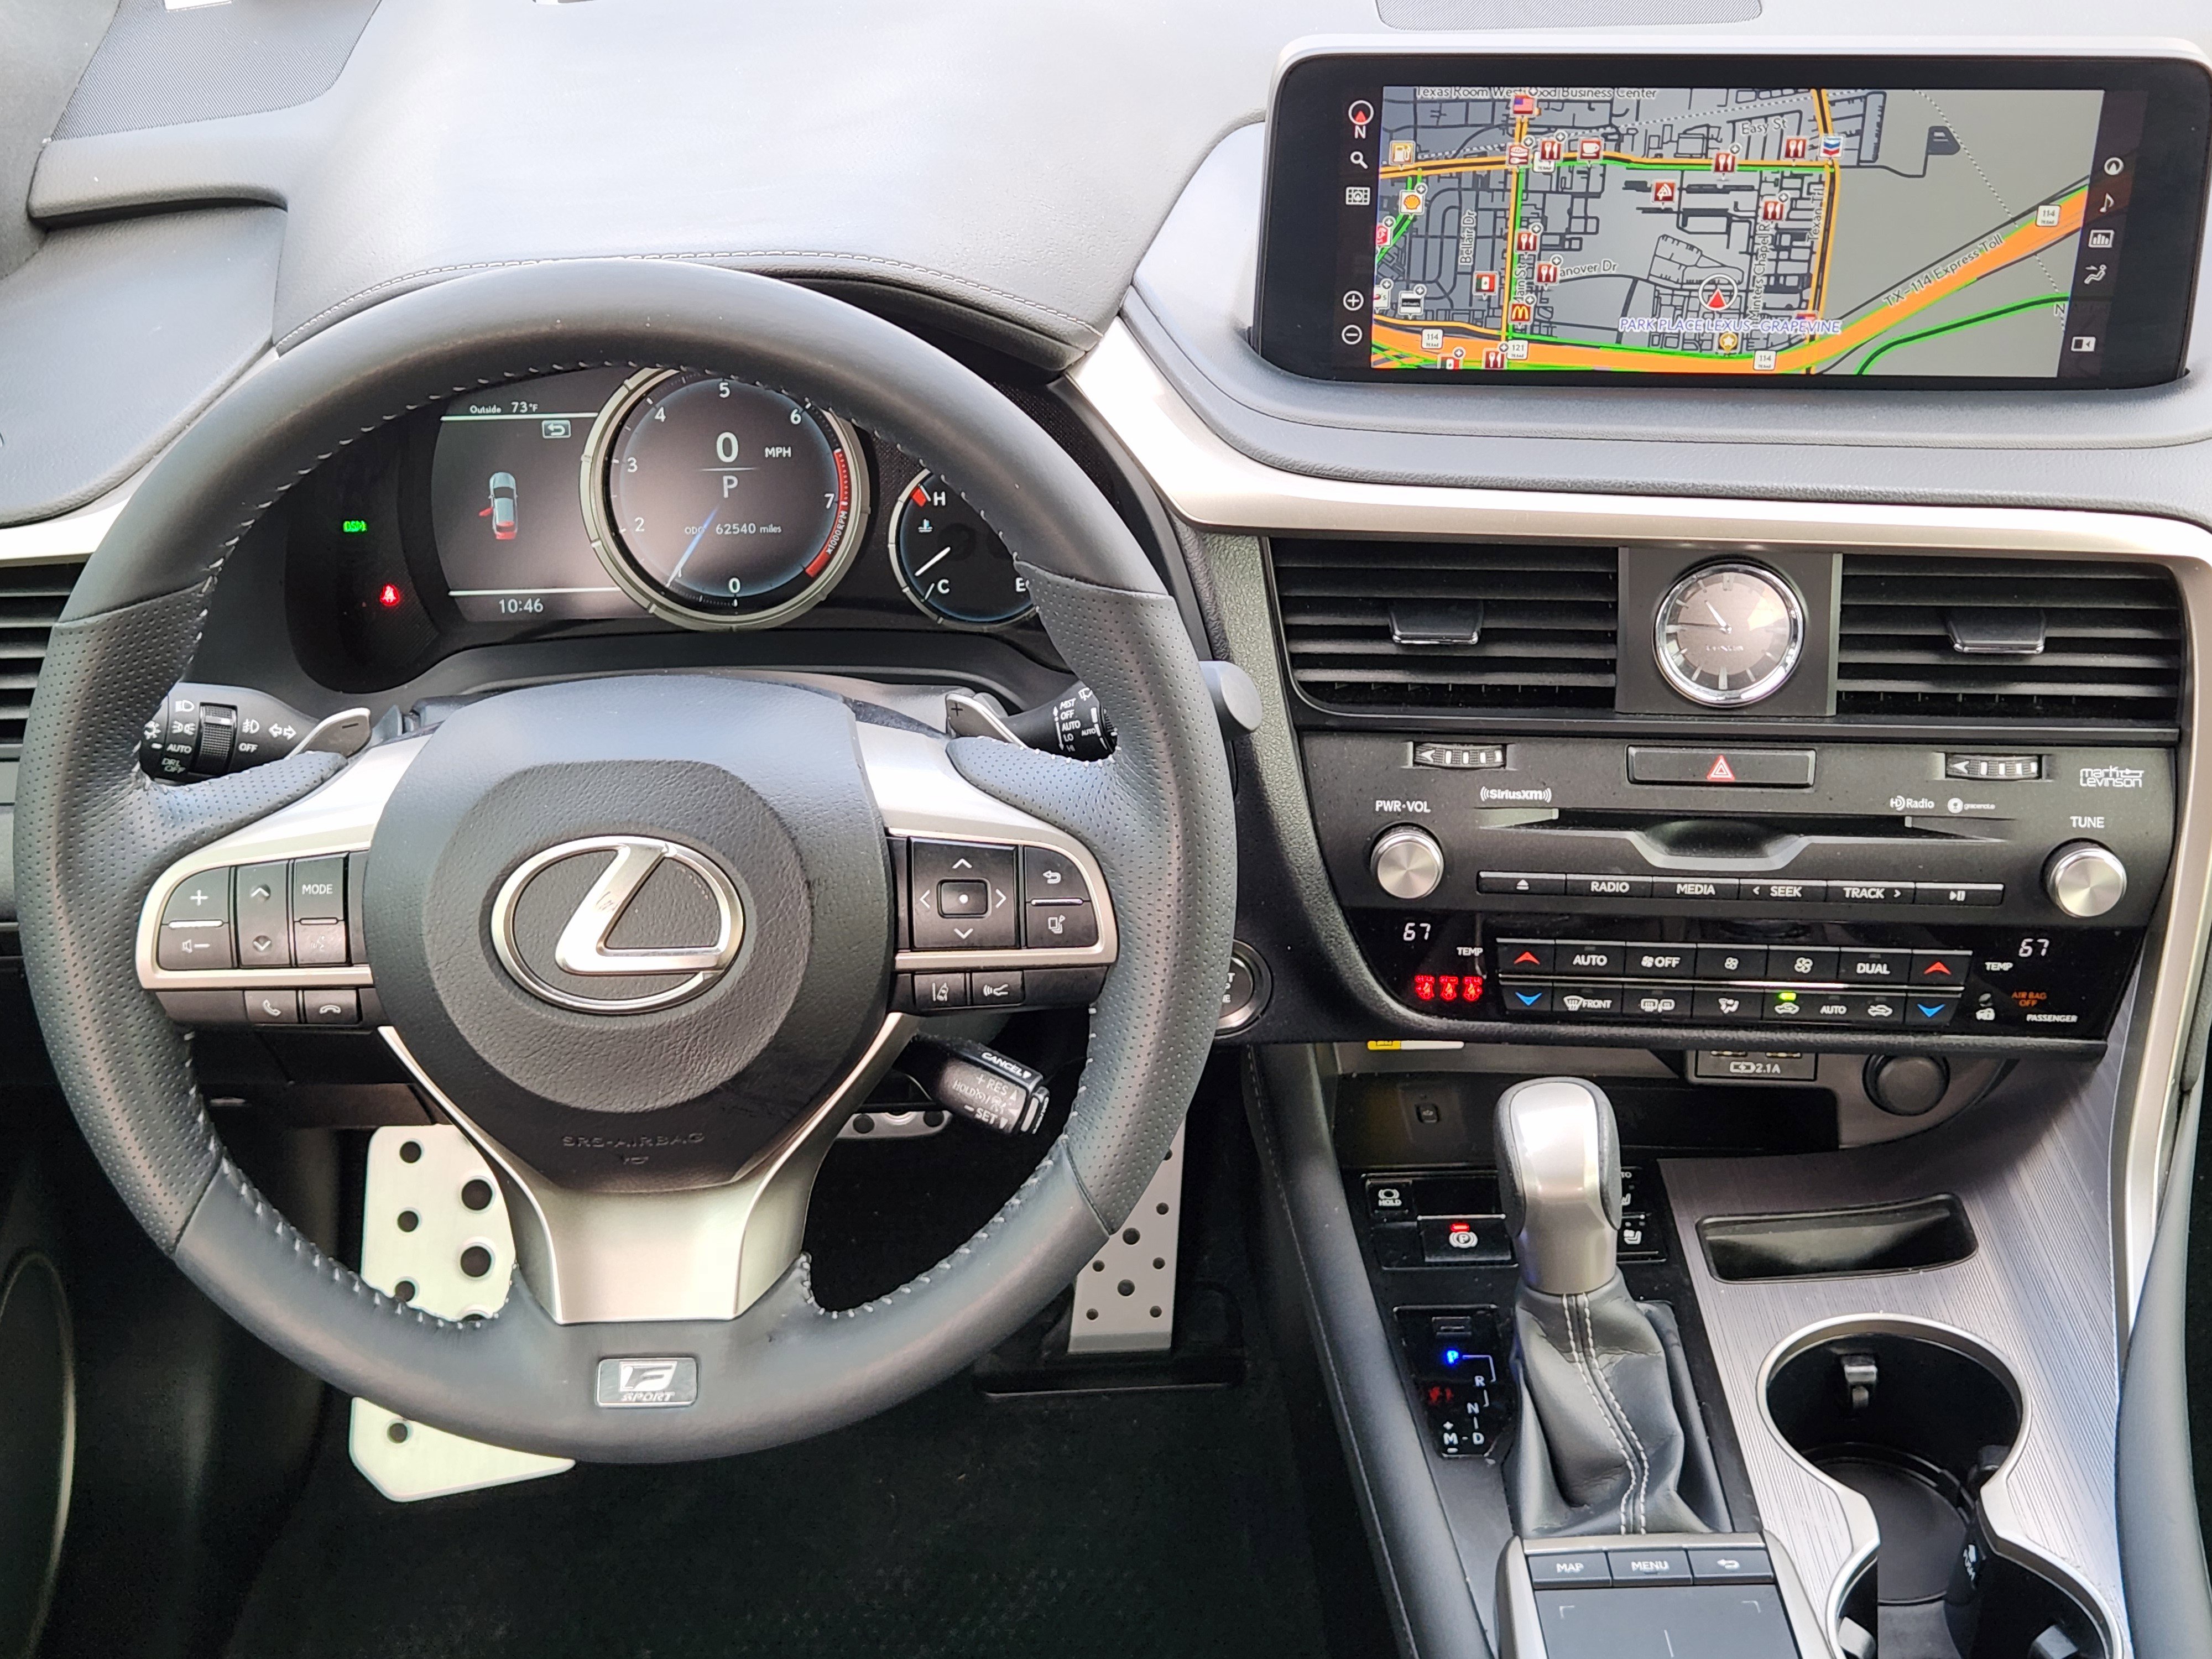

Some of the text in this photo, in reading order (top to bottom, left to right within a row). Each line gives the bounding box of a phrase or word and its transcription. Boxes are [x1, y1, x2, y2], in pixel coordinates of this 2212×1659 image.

[1562, 87, 1613, 98] Business
[1616, 88, 1656, 98] Center
[1355, 127, 1366, 138] N
[1741, 118, 1787, 137] Easy St
[1460, 211, 1477, 264] Bellair Dr
[1753, 236, 1769, 275] Chapel
[1933, 250, 1980, 280] Express
[1979, 233, 2004, 253] Toll
[1558, 260, 1617, 277] anover Dr
[1620, 319, 1656, 331] PARK
[1659, 319, 1702, 331] PLACE
[1759, 354, 1772, 363] 114
[719, 382, 731, 398] 5
[469, 404, 502, 414] Outside
[655, 407, 666, 423] 4
[790, 409, 802, 425] 6
[716, 431, 791, 462] 0 MPH
[627, 458, 638, 473] 3
[723, 475, 738, 498] P
[825, 494, 835, 509] 7
[933, 492, 946, 507] H
[634, 517, 645, 532] 2
[716, 523, 757, 535] 62540
[759, 523, 782, 534] miles
[729, 577, 740, 594] 0
[937, 579, 950, 594] C
[1015, 577, 1026, 592] E
[499, 598, 544, 614] 10:46
[1060, 698, 1076, 710] MIST
[1061, 709, 1074, 720] OFF
[1061, 720, 1082, 732] AUTO
[1064, 733, 1074, 742] LO
[1081, 728, 1096, 737] AUTO
[166, 743, 192, 754] AUTO
[238, 743, 258, 753] OFF
[1906, 797, 1935, 809] Radio
[2069, 816, 2105, 828] TUNE
[301, 884, 333, 895] MODE
[1590, 882, 1630, 893] RADIO
[1676, 884, 1715, 895] MEDIA
[1770, 886, 1802, 897] SEEK
[1844, 887, 1885, 899] TRACK
[1403, 922, 1431, 941] 67
[1456, 946, 1483, 956] TEMP
[2018, 938, 2049, 957] 67
[1573, 954, 1608, 967] AUTO
[1654, 956, 1681, 968] OFF
[1985, 961, 2013, 972] TEMP
[1856, 962, 1891, 975] DUAL
[1582, 999, 1612, 1009] FRONT
[1820, 1005, 1847, 1015] AUTO
[2026, 1014, 2078, 1023] PASSENGER
[981, 1052, 1023, 1077] CANCEL
[1755, 1063, 1781, 1074] 2.1A
[1447, 1350, 1459, 1364] P
[1474, 1375, 1485, 1387] R
[620, 1391, 676, 1402] SPORT
[1467, 1402, 1479, 1414] N
[1443, 1432, 1459, 1445] M
[1472, 1432, 1485, 1445] D
[1556, 1562, 1584, 1574] MAP
[1631, 1559, 1670, 1573] MENU
